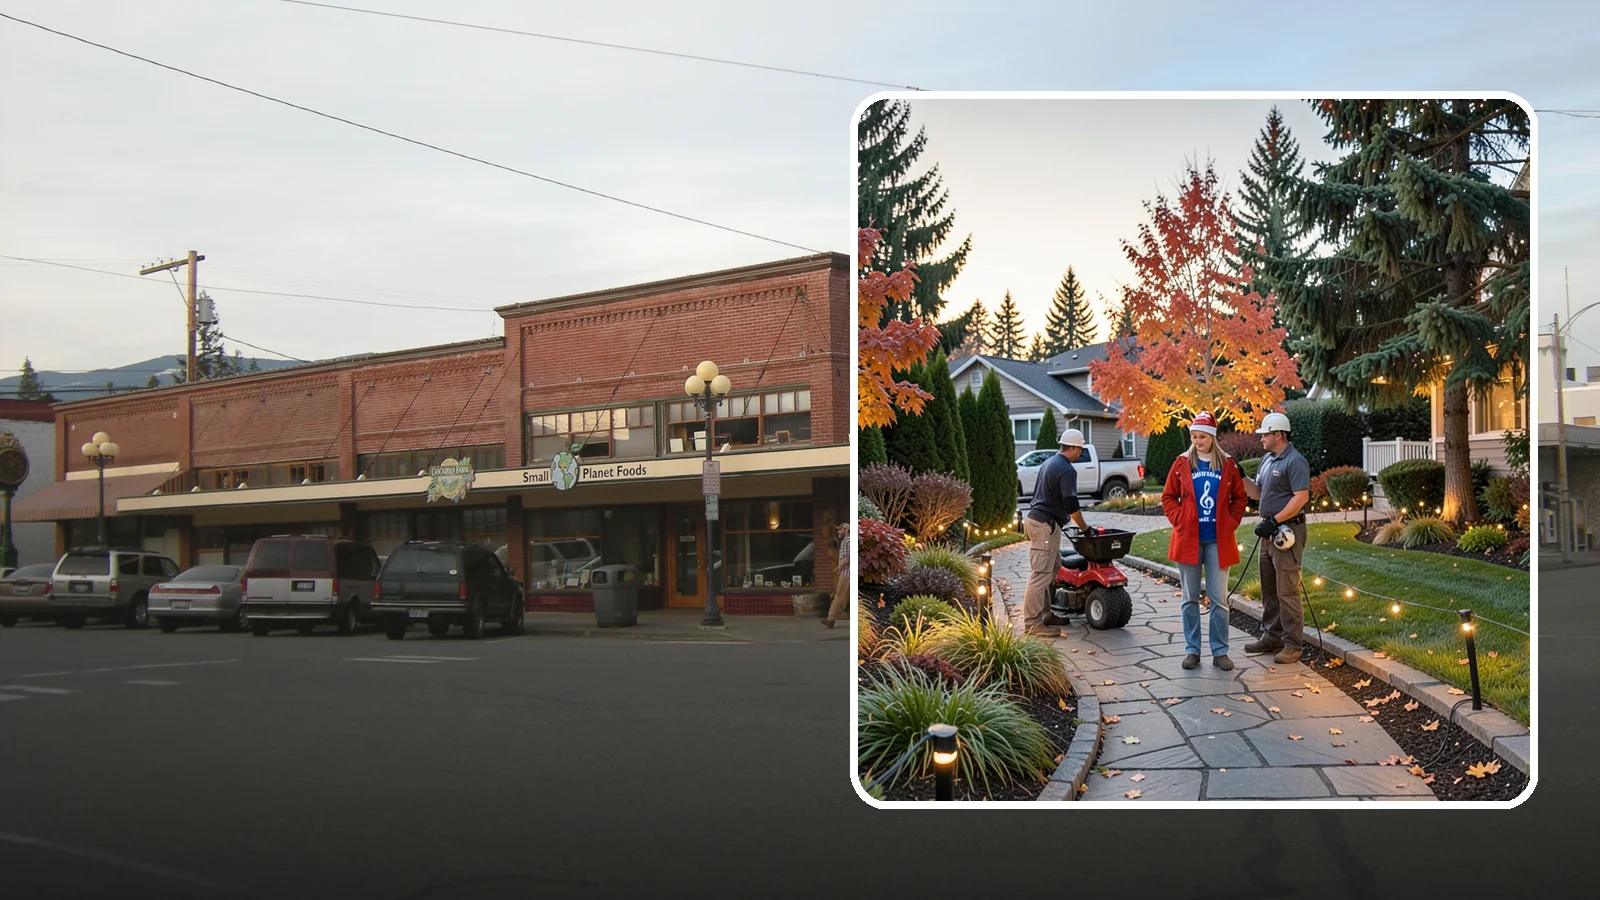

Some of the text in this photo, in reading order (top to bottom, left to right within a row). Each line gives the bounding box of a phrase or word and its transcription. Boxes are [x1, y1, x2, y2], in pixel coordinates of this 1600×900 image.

[523, 464, 647, 483] Small Planet Foods
